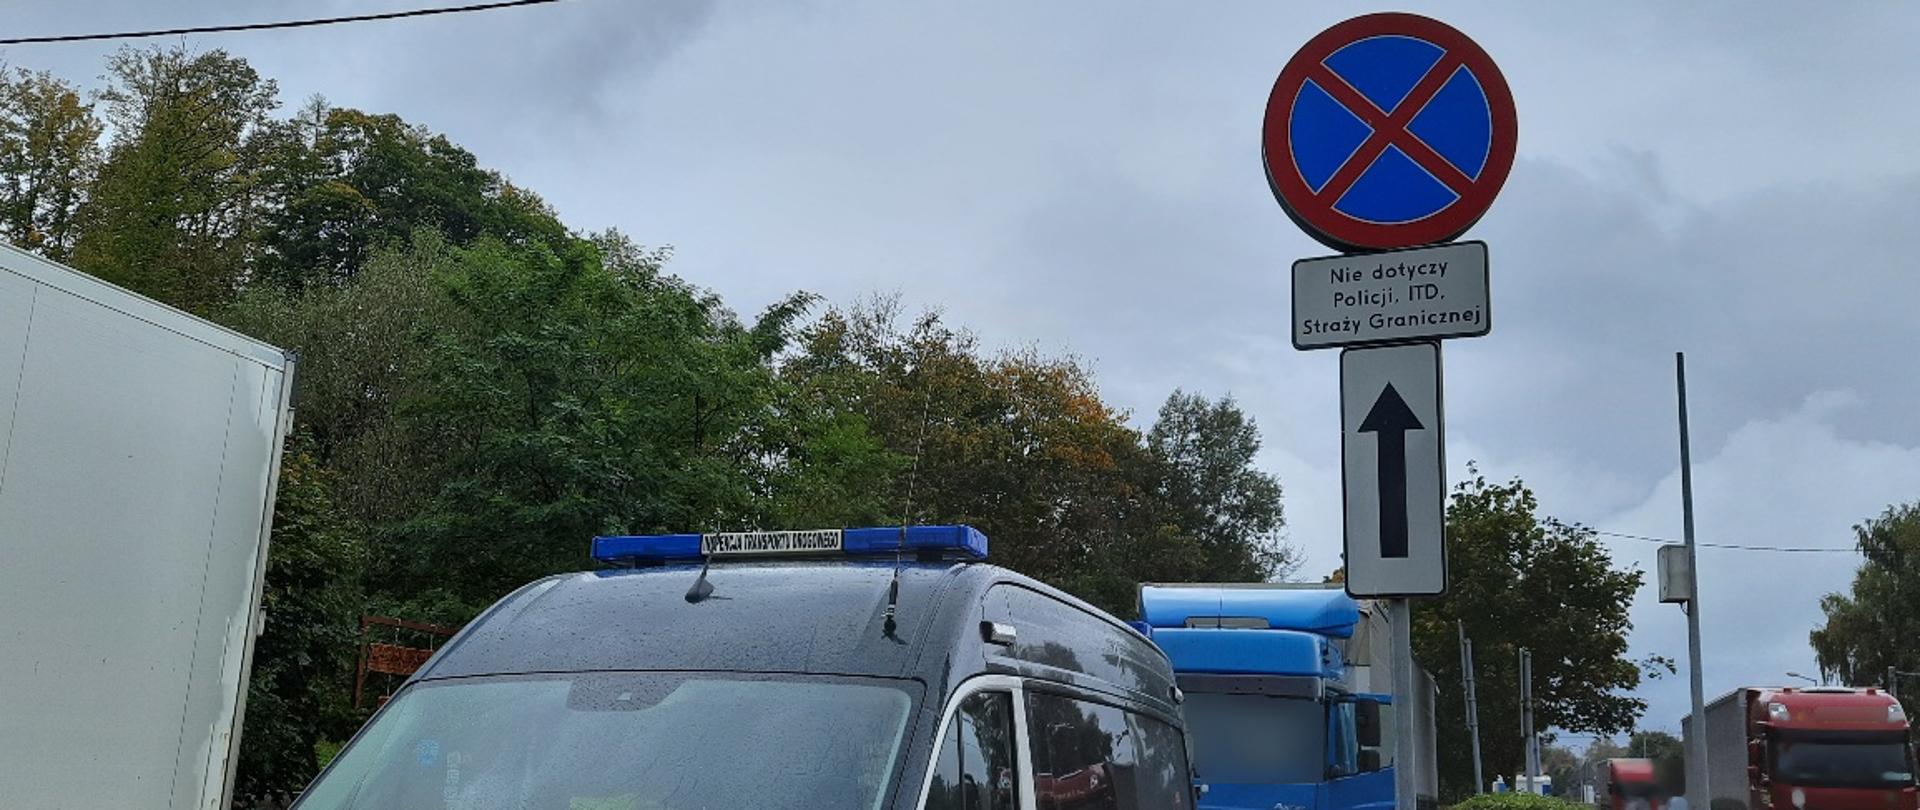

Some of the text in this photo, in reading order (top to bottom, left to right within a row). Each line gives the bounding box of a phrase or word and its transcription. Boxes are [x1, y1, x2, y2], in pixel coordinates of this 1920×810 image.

[1331, 262, 1448, 284] Nie dotyczy
[1334, 288, 1399, 308] Policji,
[1303, 306, 1480, 334] Straży Granicznej
